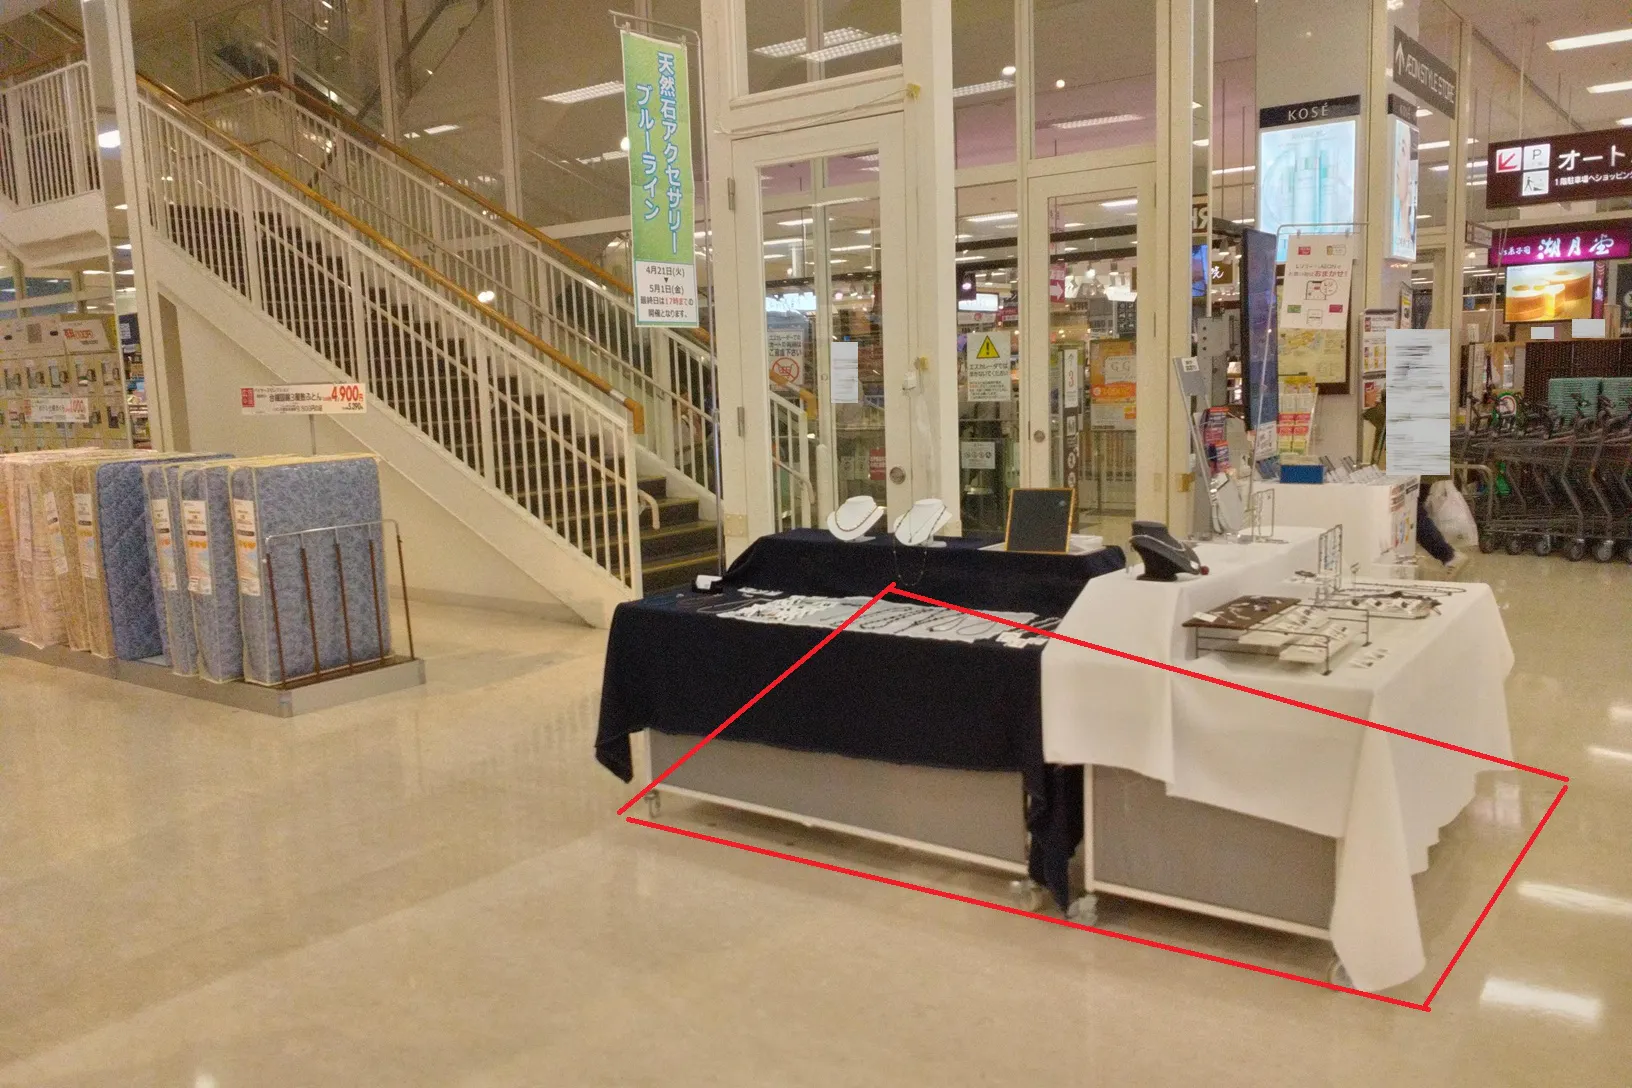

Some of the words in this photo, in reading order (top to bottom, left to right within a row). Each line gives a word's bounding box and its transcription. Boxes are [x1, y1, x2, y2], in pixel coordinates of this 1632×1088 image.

[1288, 102, 1329, 121] KOSÉ
[636, 83, 660, 221] ブルーライン
[657, 52, 682, 254] 天然石アクセサリー
[1532, 149, 1542, 160] P
[1558, 144, 1632, 171] オート
[1537, 234, 1615, 260] 湖月堂
[646, 265, 685, 278] 4月21日(火)
[649, 283, 684, 295] 5月1日(金)
[640, 295, 694, 306] 最終日は17時までの
